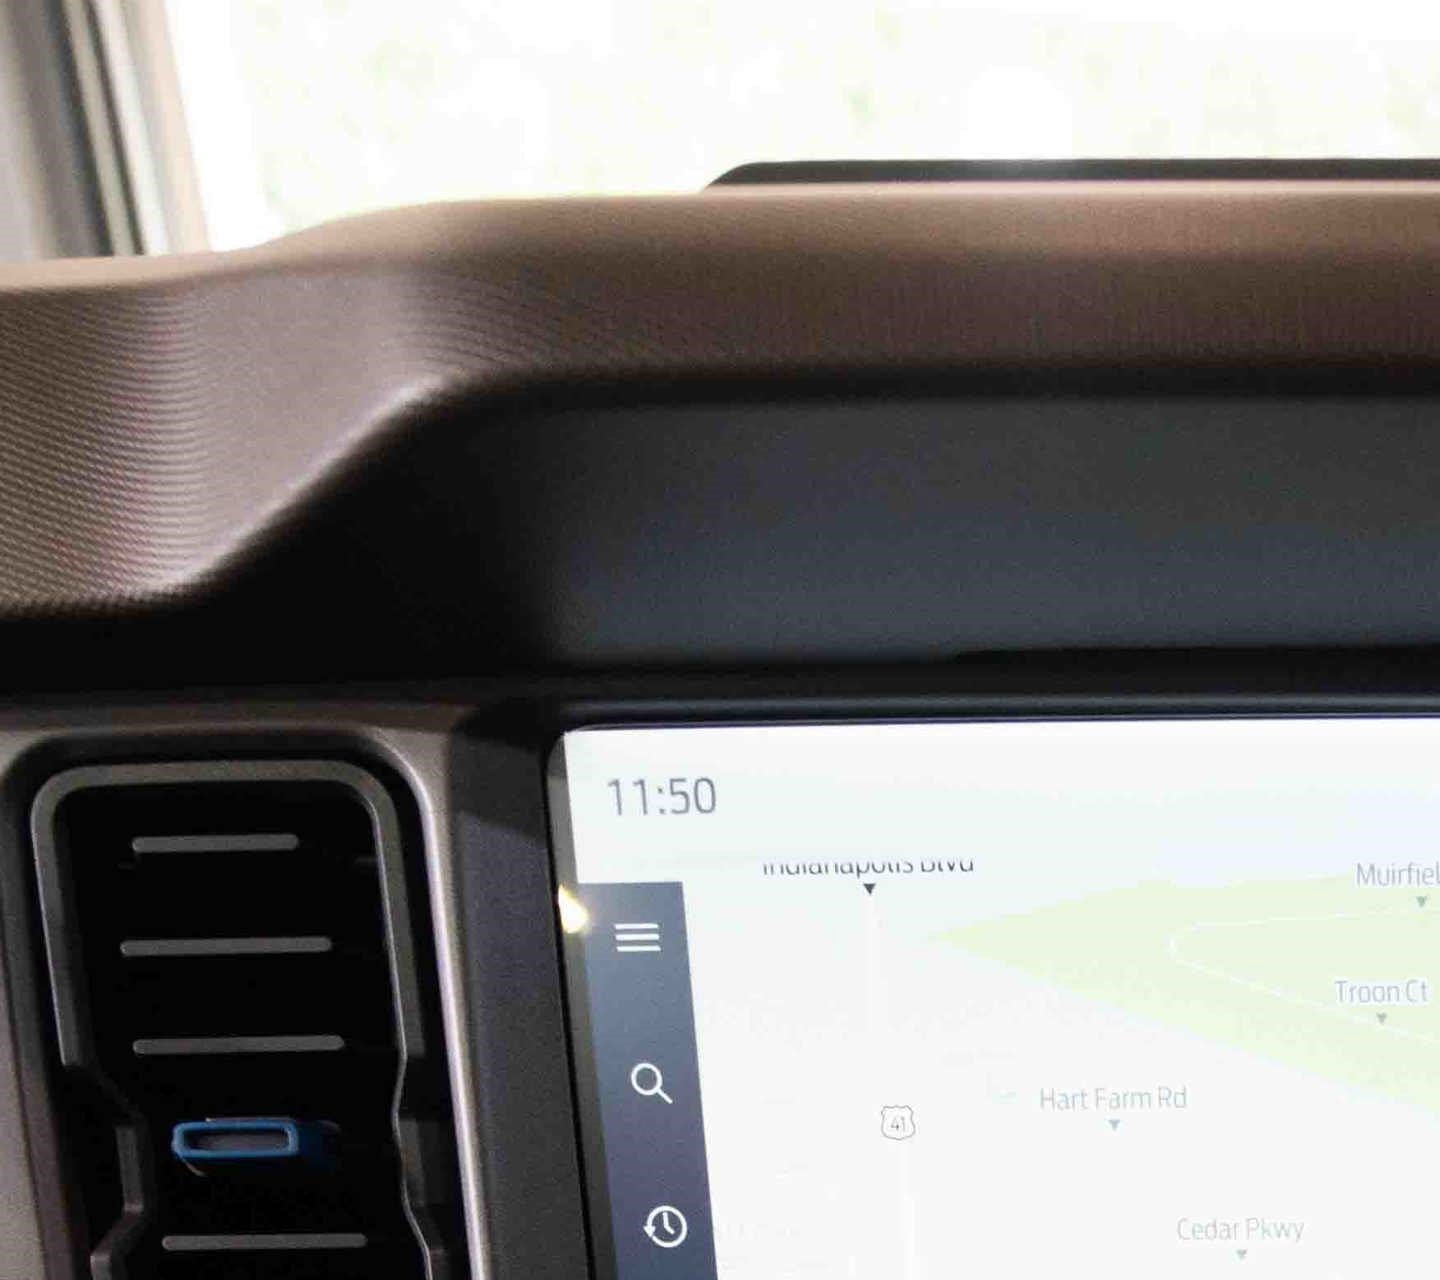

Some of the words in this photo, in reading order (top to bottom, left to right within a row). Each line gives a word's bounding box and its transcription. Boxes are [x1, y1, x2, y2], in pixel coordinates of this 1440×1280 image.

[607, 776, 718, 817] 11:50
[1334, 979, 1400, 1004] Troon
[1404, 979, 1429, 1003] Ct
[1039, 1085, 1090, 1111] Hart
[1094, 1085, 1152, 1111] Farm
[1157, 1085, 1188, 1110] Rd
[889, 1114, 907, 1133] 41
[1175, 1216, 1240, 1242] Cedar
[1245, 1216, 1306, 1246] Pkwy
